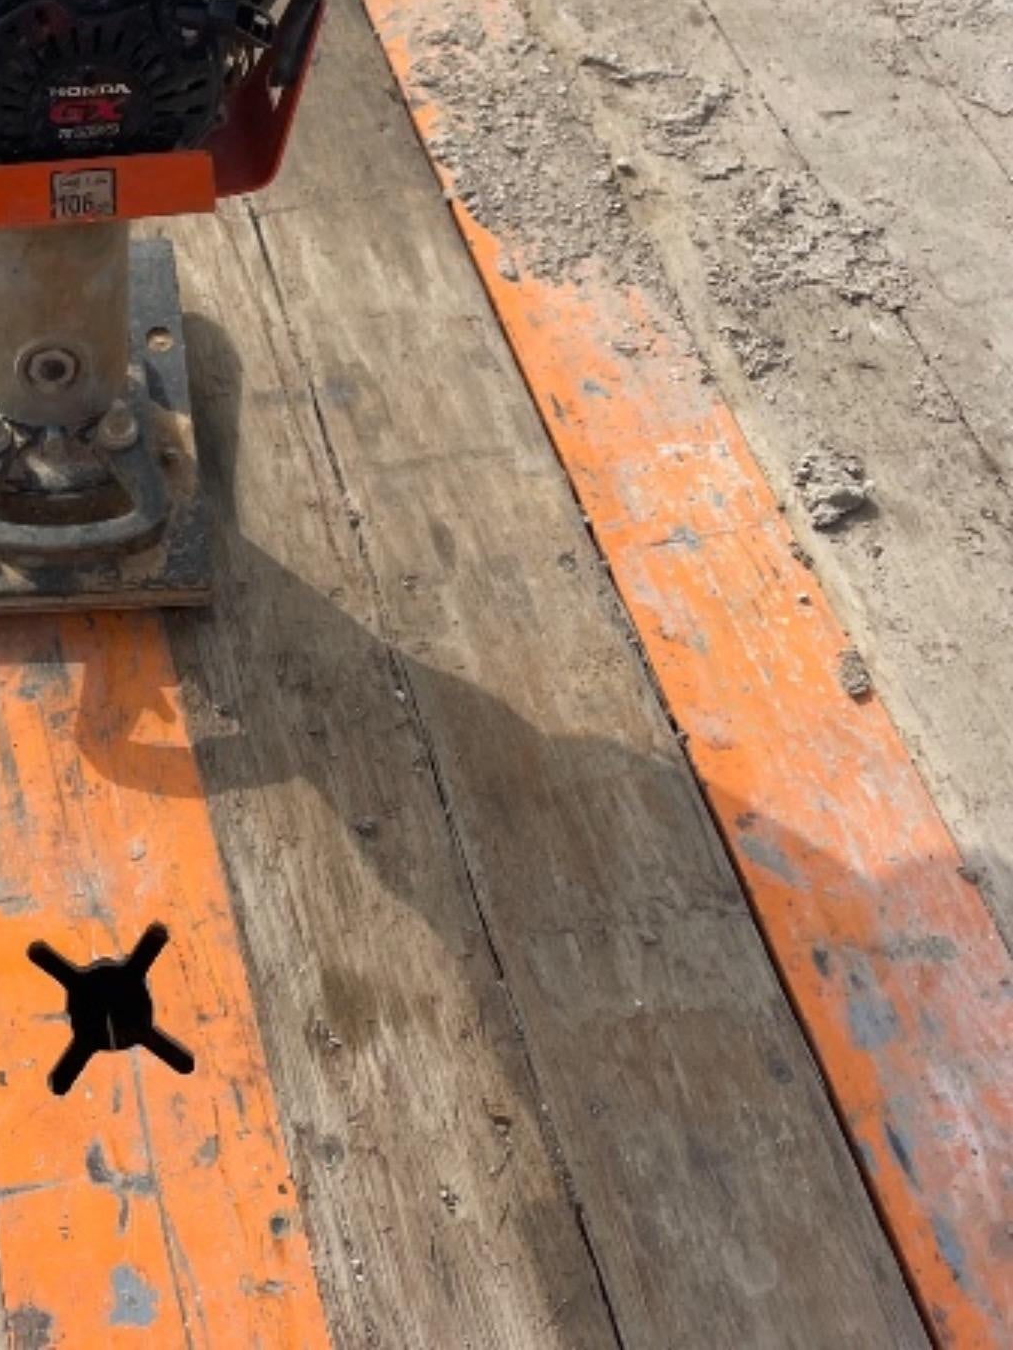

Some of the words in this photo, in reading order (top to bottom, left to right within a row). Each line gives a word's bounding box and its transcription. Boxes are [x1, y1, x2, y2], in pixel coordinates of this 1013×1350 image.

[49, 82, 132, 97] HONDA
[49, 97, 125, 125] GX
[59, 192, 95, 214] 106
